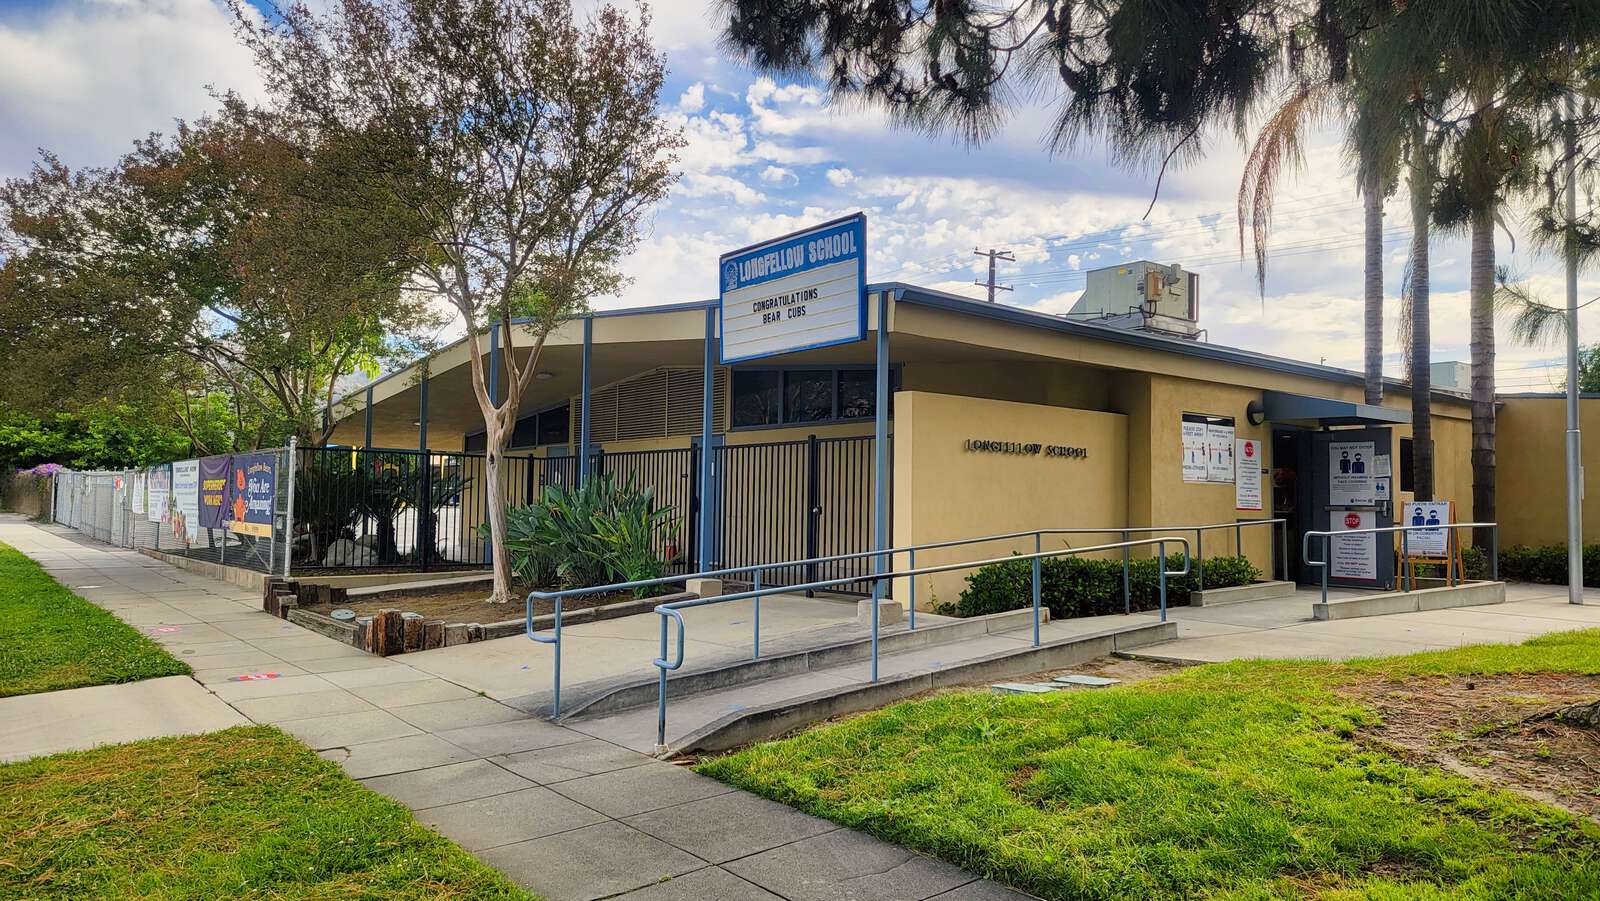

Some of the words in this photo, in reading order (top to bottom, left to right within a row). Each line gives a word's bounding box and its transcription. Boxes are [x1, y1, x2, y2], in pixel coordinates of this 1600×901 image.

[739, 243, 804, 282] LONGFELLOW
[808, 230, 857, 263] SCHOOL
[752, 288, 818, 313] CONGRATULATIONS
[762, 308, 781, 324] BEAR
[787, 305, 806, 320] CUBS
[964, 439, 1042, 456] LONGFELLOW
[1045, 444, 1088, 460] SCHOOL
[248, 477, 260, 497] You
[260, 478, 270, 493] Are
[1344, 517, 1361, 525] STOP
